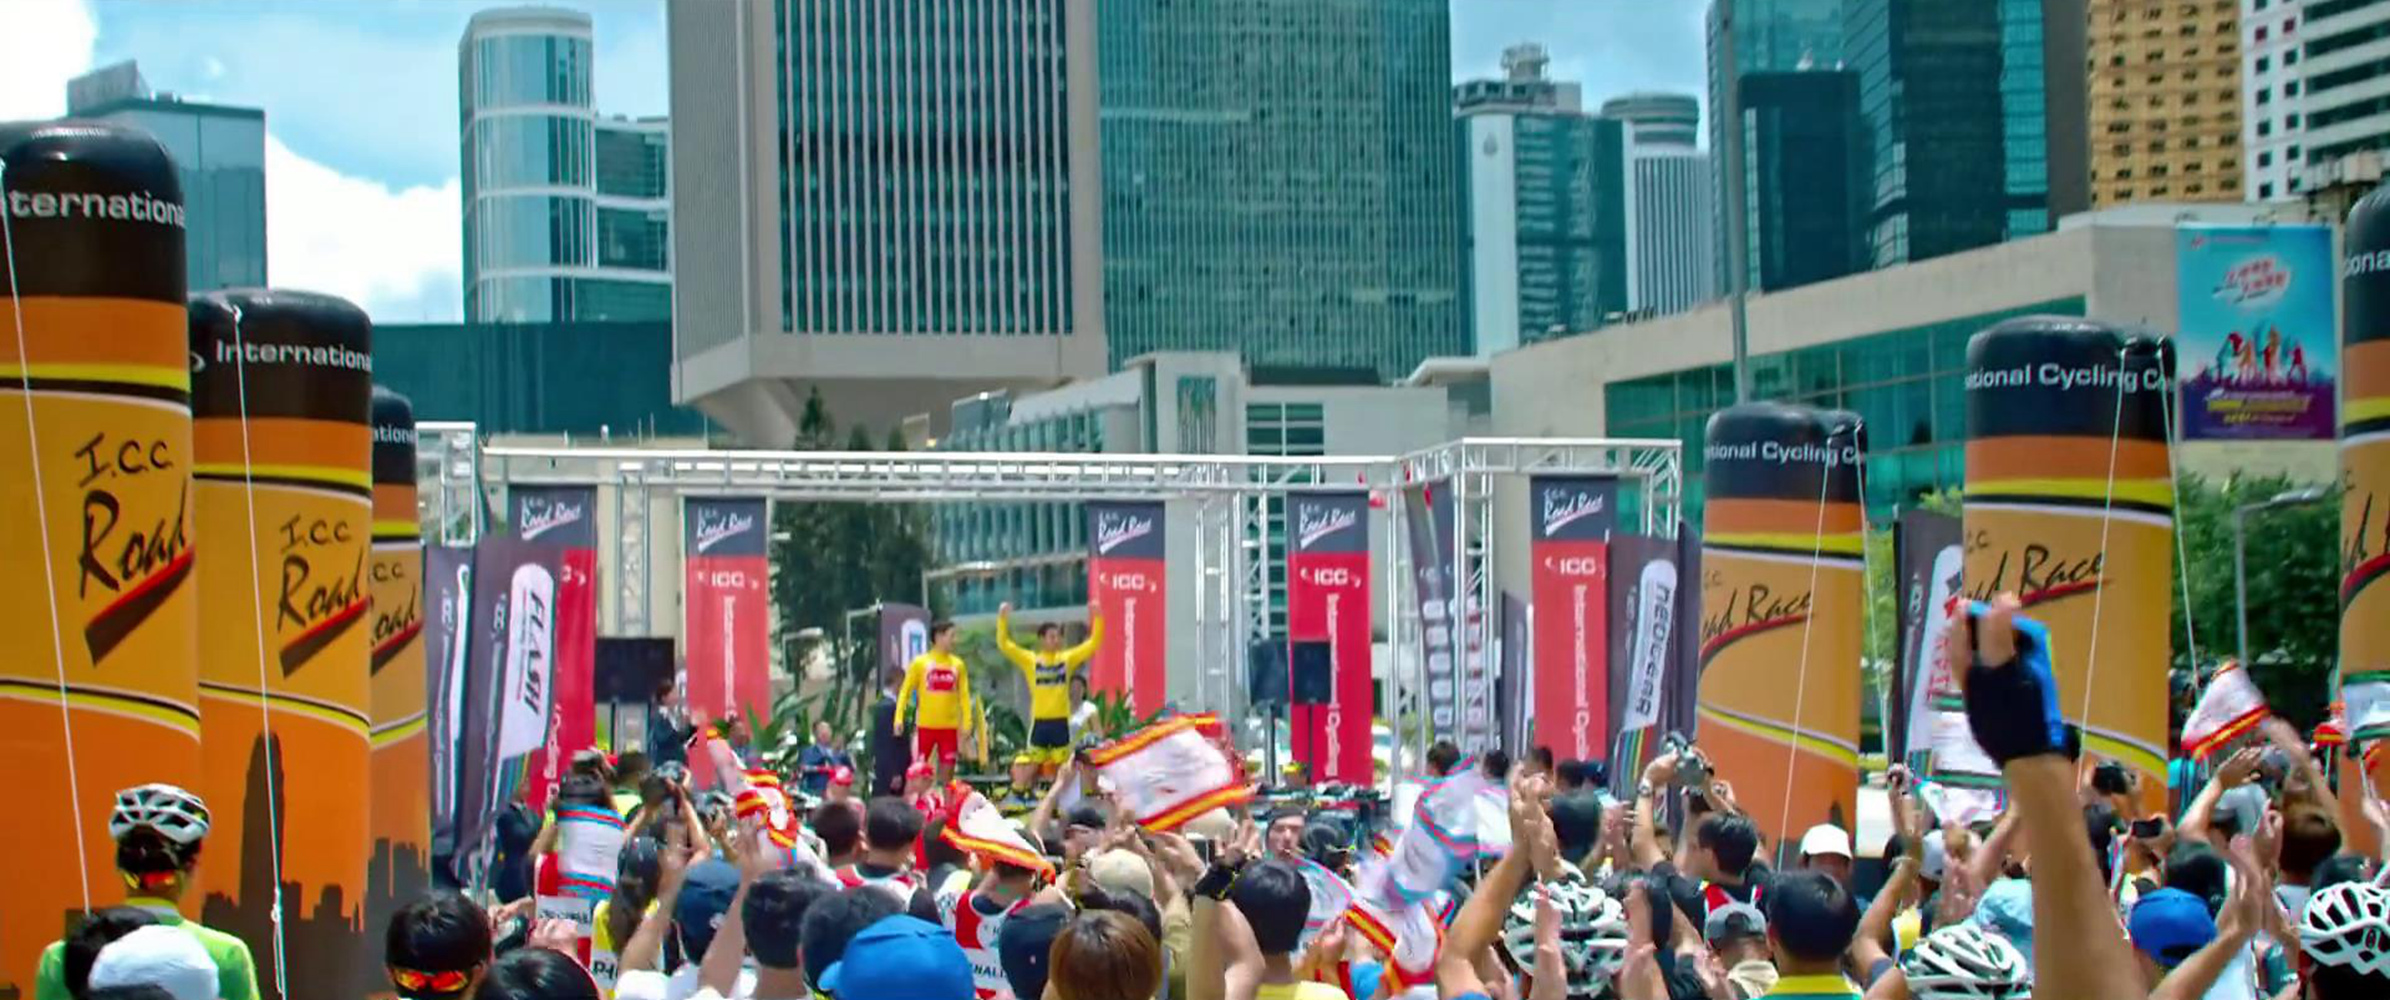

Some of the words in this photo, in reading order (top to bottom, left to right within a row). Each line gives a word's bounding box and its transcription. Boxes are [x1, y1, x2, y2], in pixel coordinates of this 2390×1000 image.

[2039, 363, 2138, 393] Cycling
[1762, 441, 1838, 467] Cycling
[78, 478, 185, 600] Road
[1314, 568, 1349, 586] ICC
[1560, 557, 1597, 575] ICC
[2019, 544, 2104, 600] Race
[277, 546, 360, 633] Road
[371, 583, 416, 646] oad
